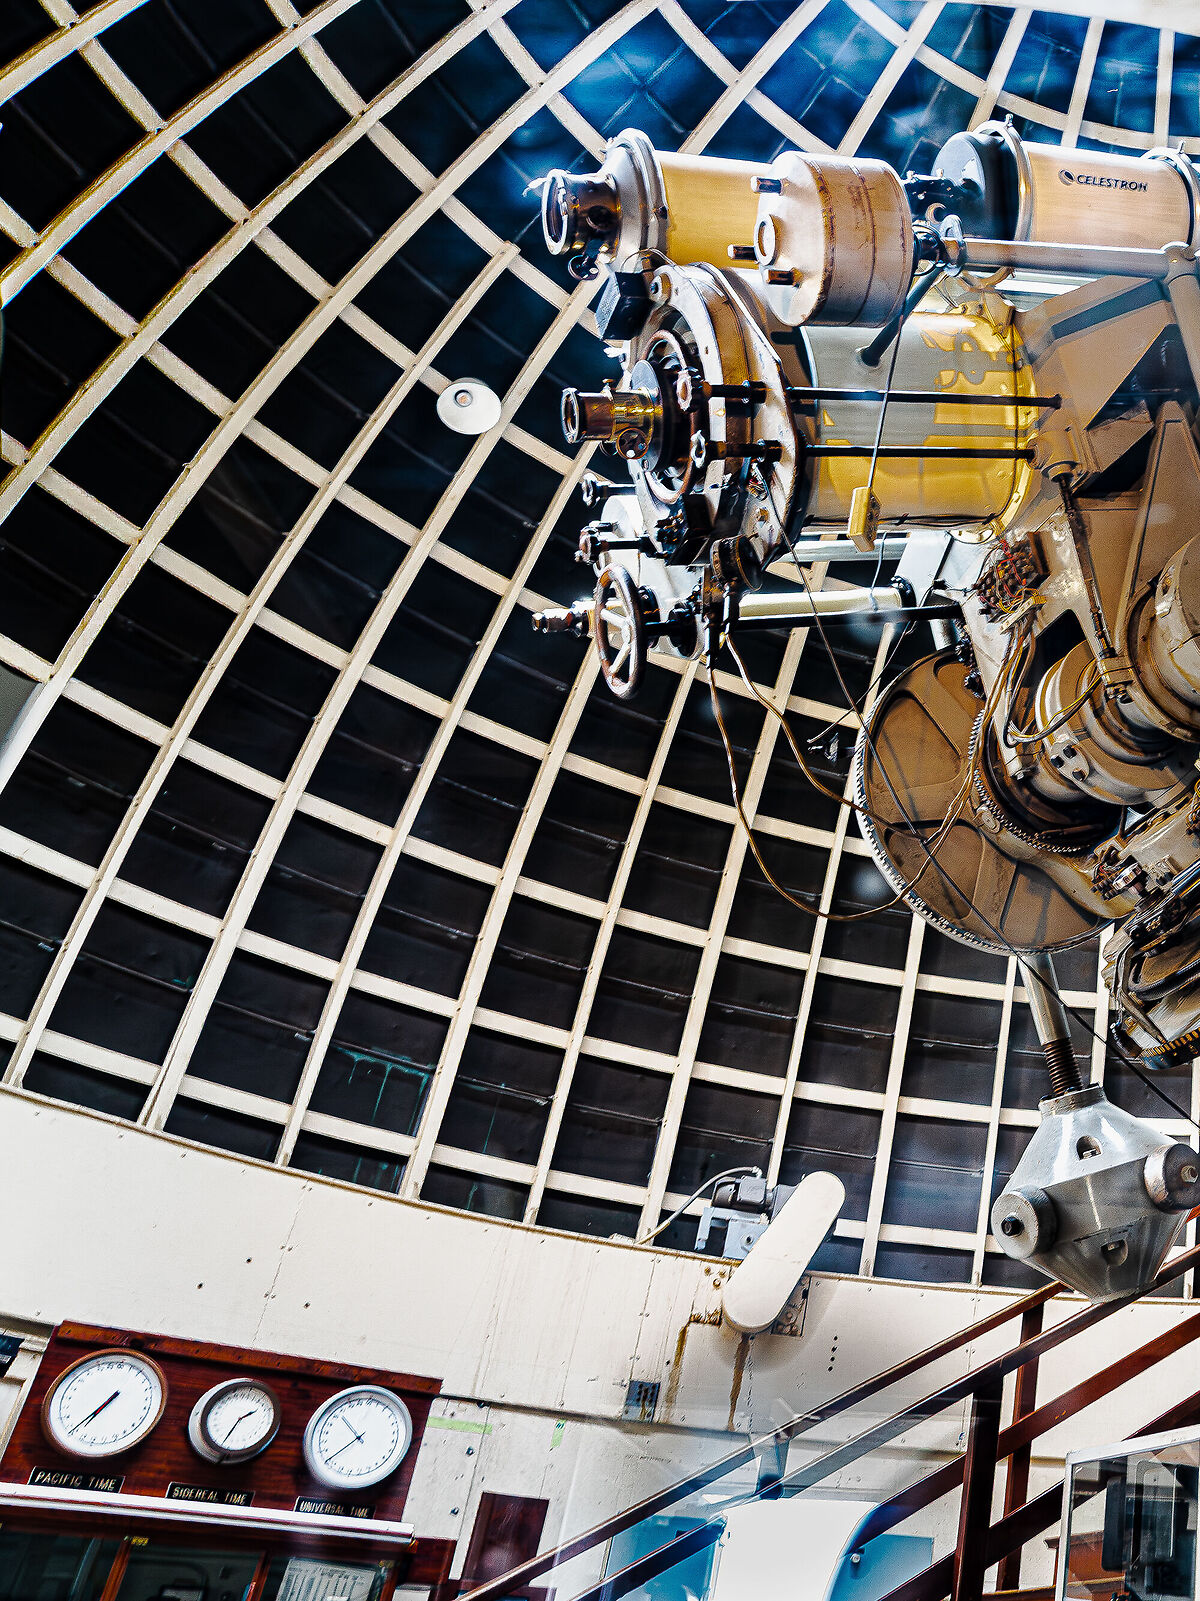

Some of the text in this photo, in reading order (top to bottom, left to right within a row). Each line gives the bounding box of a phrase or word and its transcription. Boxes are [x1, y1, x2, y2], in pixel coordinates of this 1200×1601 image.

[1076, 174, 1148, 192] CELESTRON
[34, 1470, 117, 1492] PACIFIC TIME
[172, 1486, 248, 1506] SIDEREAL TIME
[299, 1500, 345, 1515] UNIVERSAL
